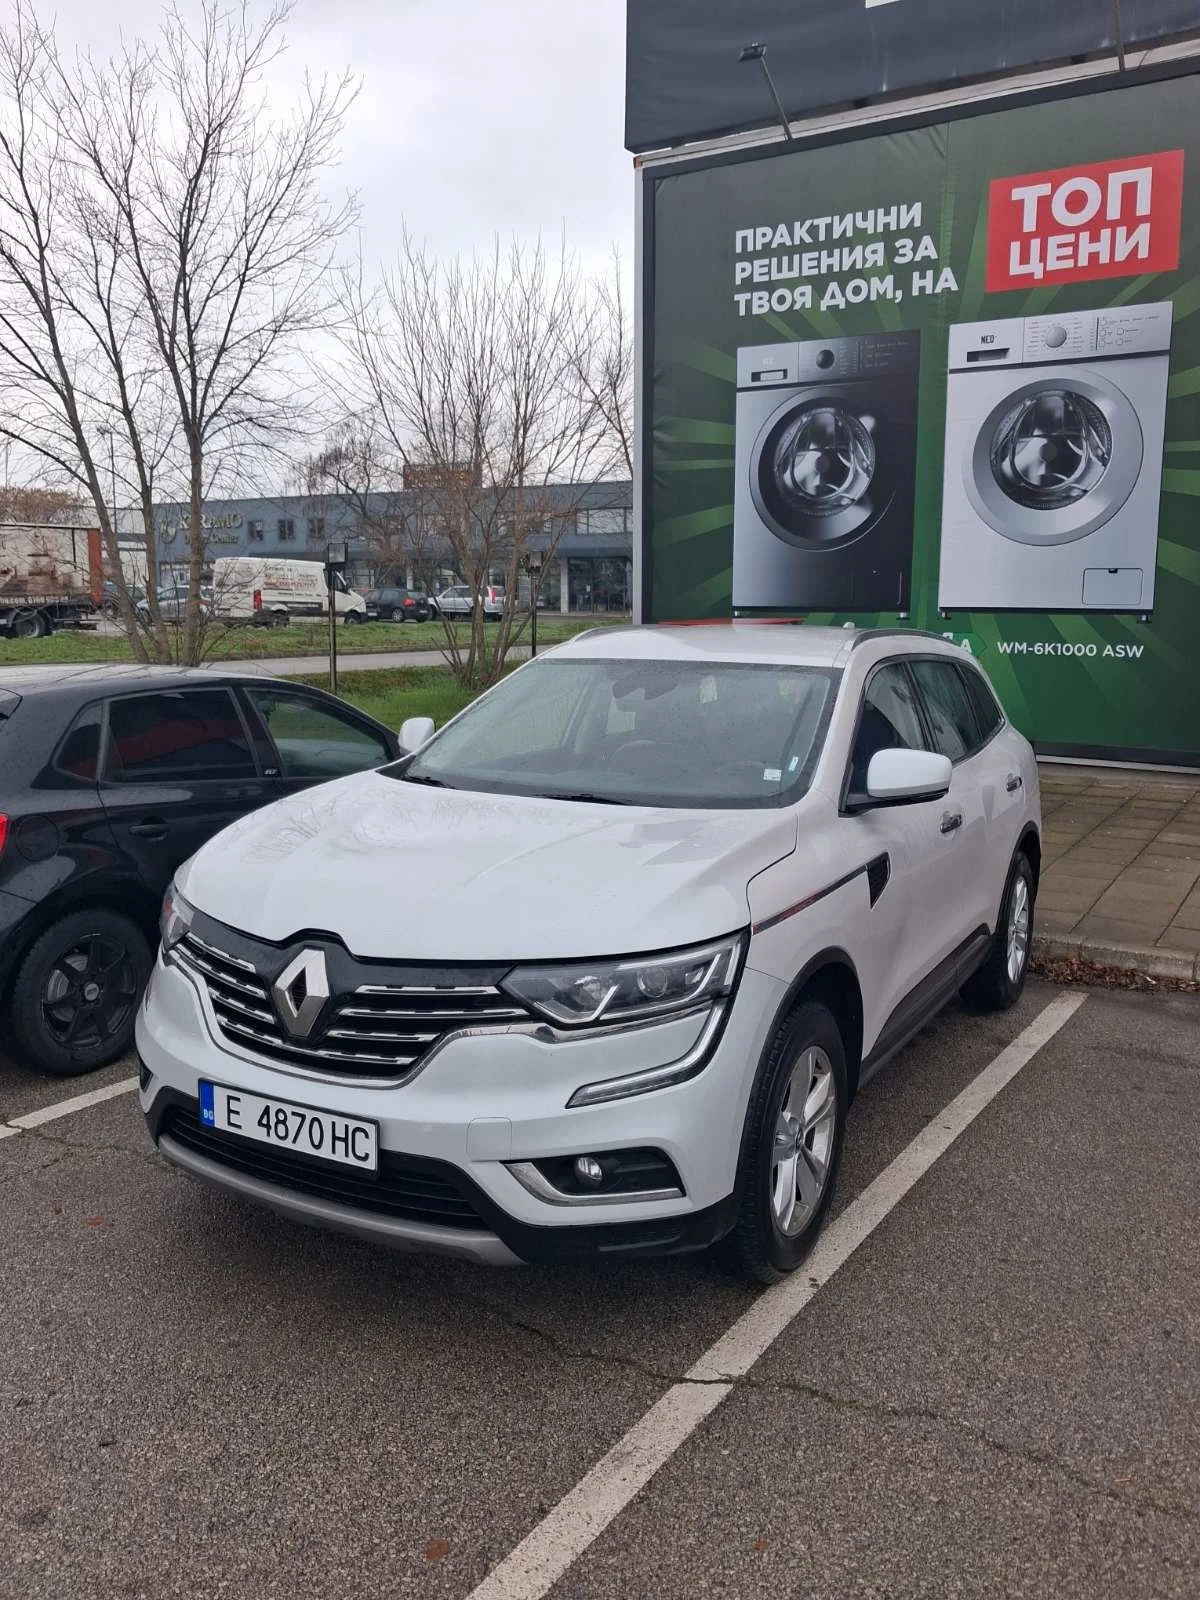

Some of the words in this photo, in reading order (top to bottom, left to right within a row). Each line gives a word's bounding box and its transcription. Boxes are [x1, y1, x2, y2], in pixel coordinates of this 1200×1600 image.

[1011, 166, 1153, 232] ТОП
[735, 202, 922, 254] ПРАКТИЧНИ
[1009, 222, 1151, 280] ЦЕНИ
[735, 242, 885, 286] РЕШЕНИЯ
[894, 235, 938, 265] ЗА
[734, 285, 812, 316] ТВОЯ
[820, 275, 903, 311] ДОМ,
[911, 267, 959, 296] НА
[997, 641, 1098, 657] WM-6K1000
[1102, 645, 1145, 658] ASW
[203, 1108, 214, 1121] BG
[226, 1094, 243, 1130] E
[257, 1104, 325, 1150] 4870
[331, 1120, 370, 1162] HC
